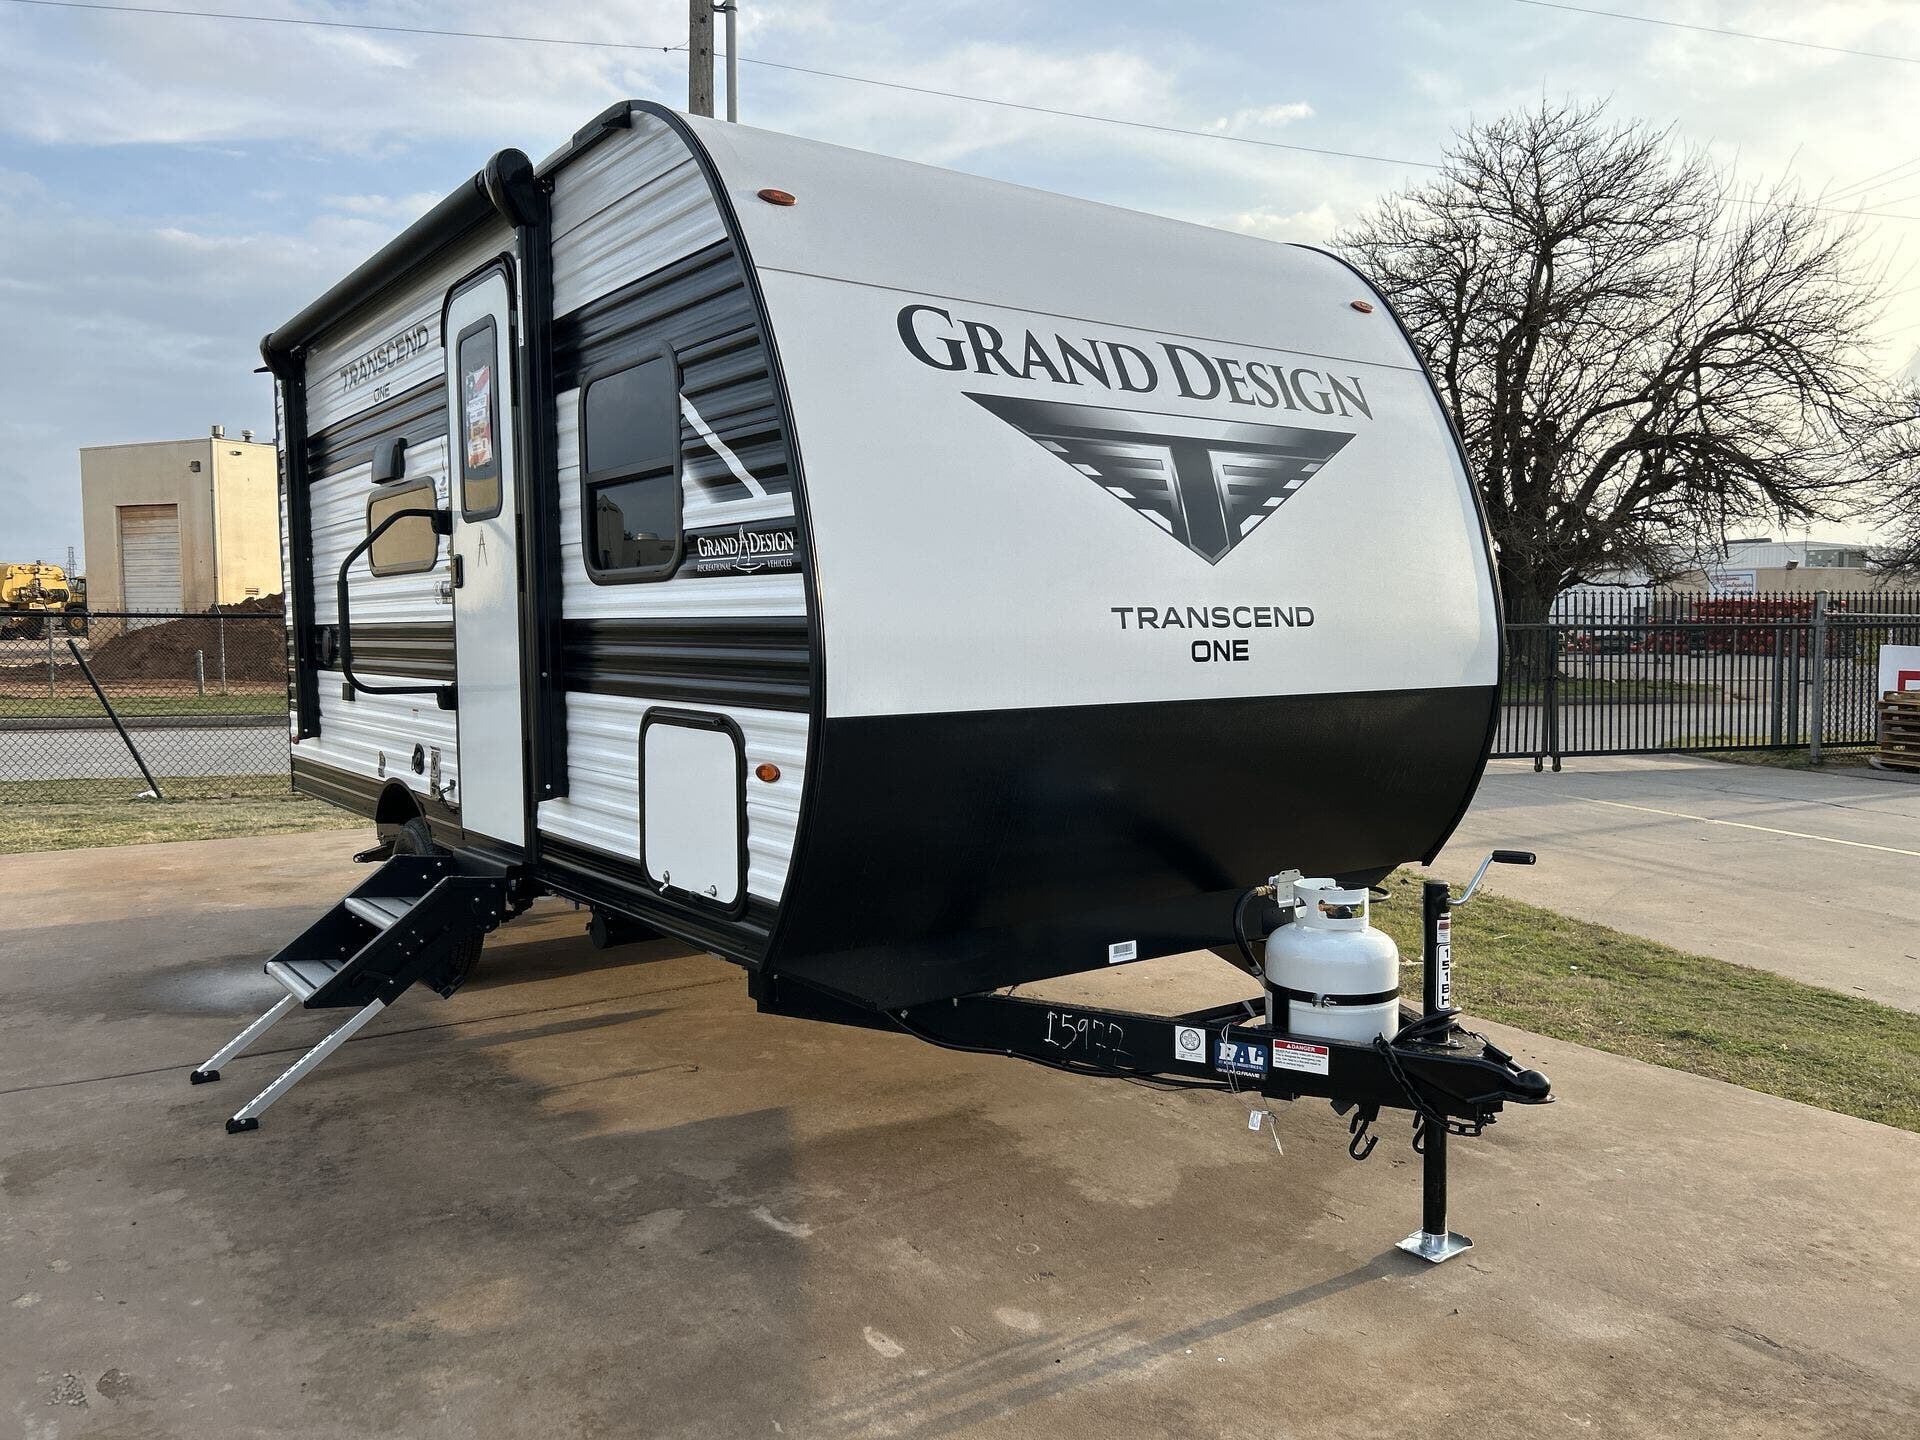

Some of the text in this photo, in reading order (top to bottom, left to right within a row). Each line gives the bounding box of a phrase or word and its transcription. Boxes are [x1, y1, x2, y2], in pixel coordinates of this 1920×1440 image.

[341, 325, 429, 392] TRANSCEND
[897, 304, 1373, 420] GRAND DESIGN
[373, 382, 391, 403] ONE
[697, 531, 794, 557] GRAND DESIGN
[697, 558, 792, 572] RECREATIONAL VEHICLES
[1111, 606, 1314, 629] TRANSCEND
[1191, 639, 1249, 662] ONE
[1219, 1042, 1264, 1066] BAL
[1291, 1044, 1316, 1053] DANGER
